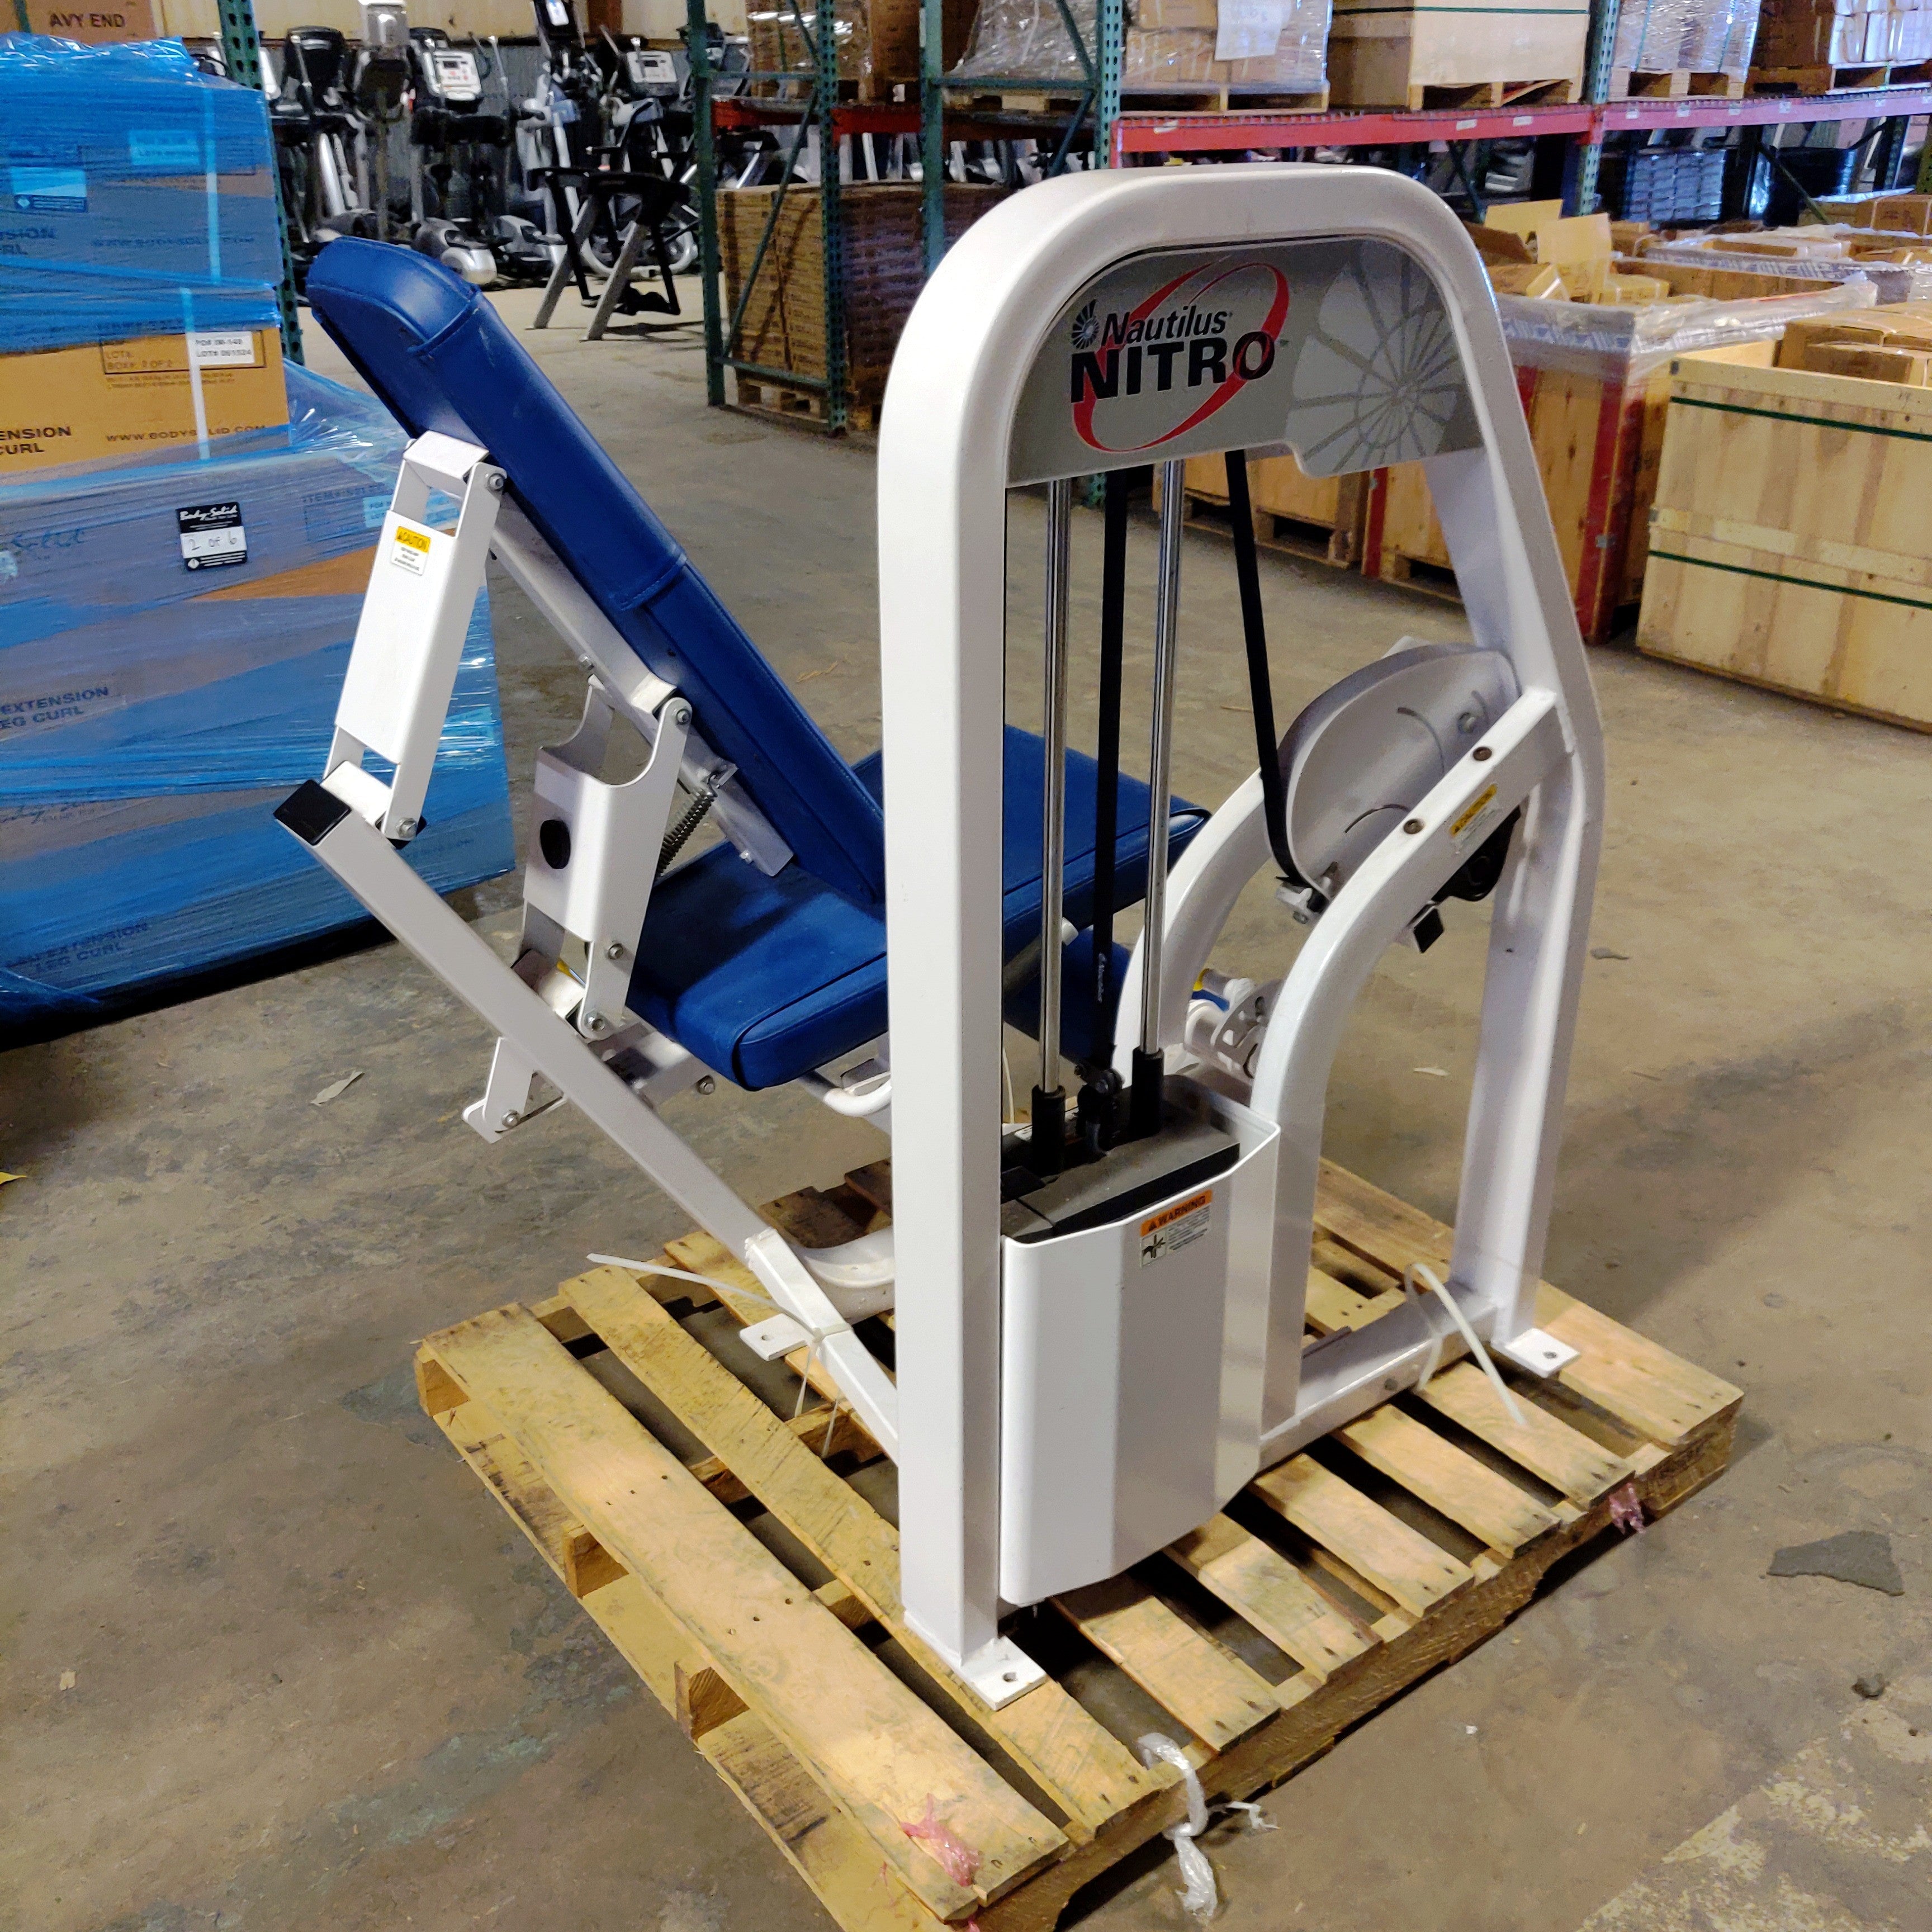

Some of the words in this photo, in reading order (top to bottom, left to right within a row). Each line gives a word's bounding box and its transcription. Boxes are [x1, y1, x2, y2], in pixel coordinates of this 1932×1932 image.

[89, 13, 125, 27] END
[1101, 305, 1227, 346] Nautilus
[1071, 330, 1275, 403] NITRO
[106, 425, 266, 442] WWW.BODYSLID.COM
[188, 538, 201, 551] 2
[228, 531, 237, 545] 6
[0, 686, 109, 715] EXTENSION
[32, 705, 84, 723] CURL
[1158, 1195, 1205, 1225] WARNING
